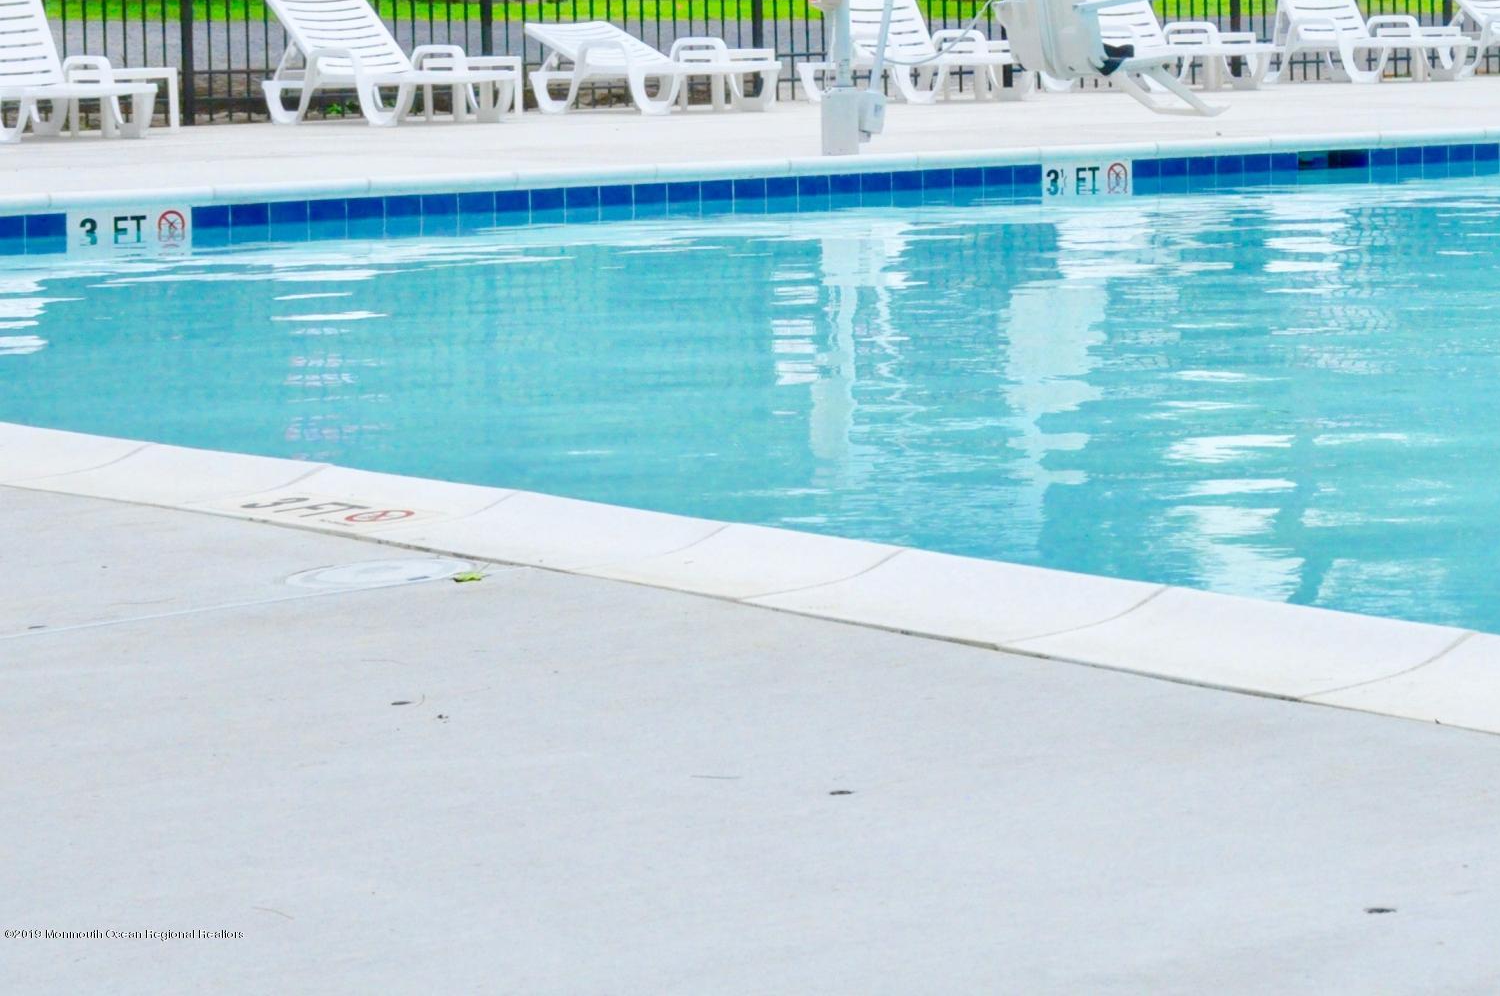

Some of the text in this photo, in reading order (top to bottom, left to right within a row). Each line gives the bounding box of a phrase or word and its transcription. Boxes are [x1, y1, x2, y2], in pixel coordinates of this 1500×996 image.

[1076, 167, 1100, 195] FT
[80, 214, 147, 245] 3 FT
[273, 502, 370, 517] FT
